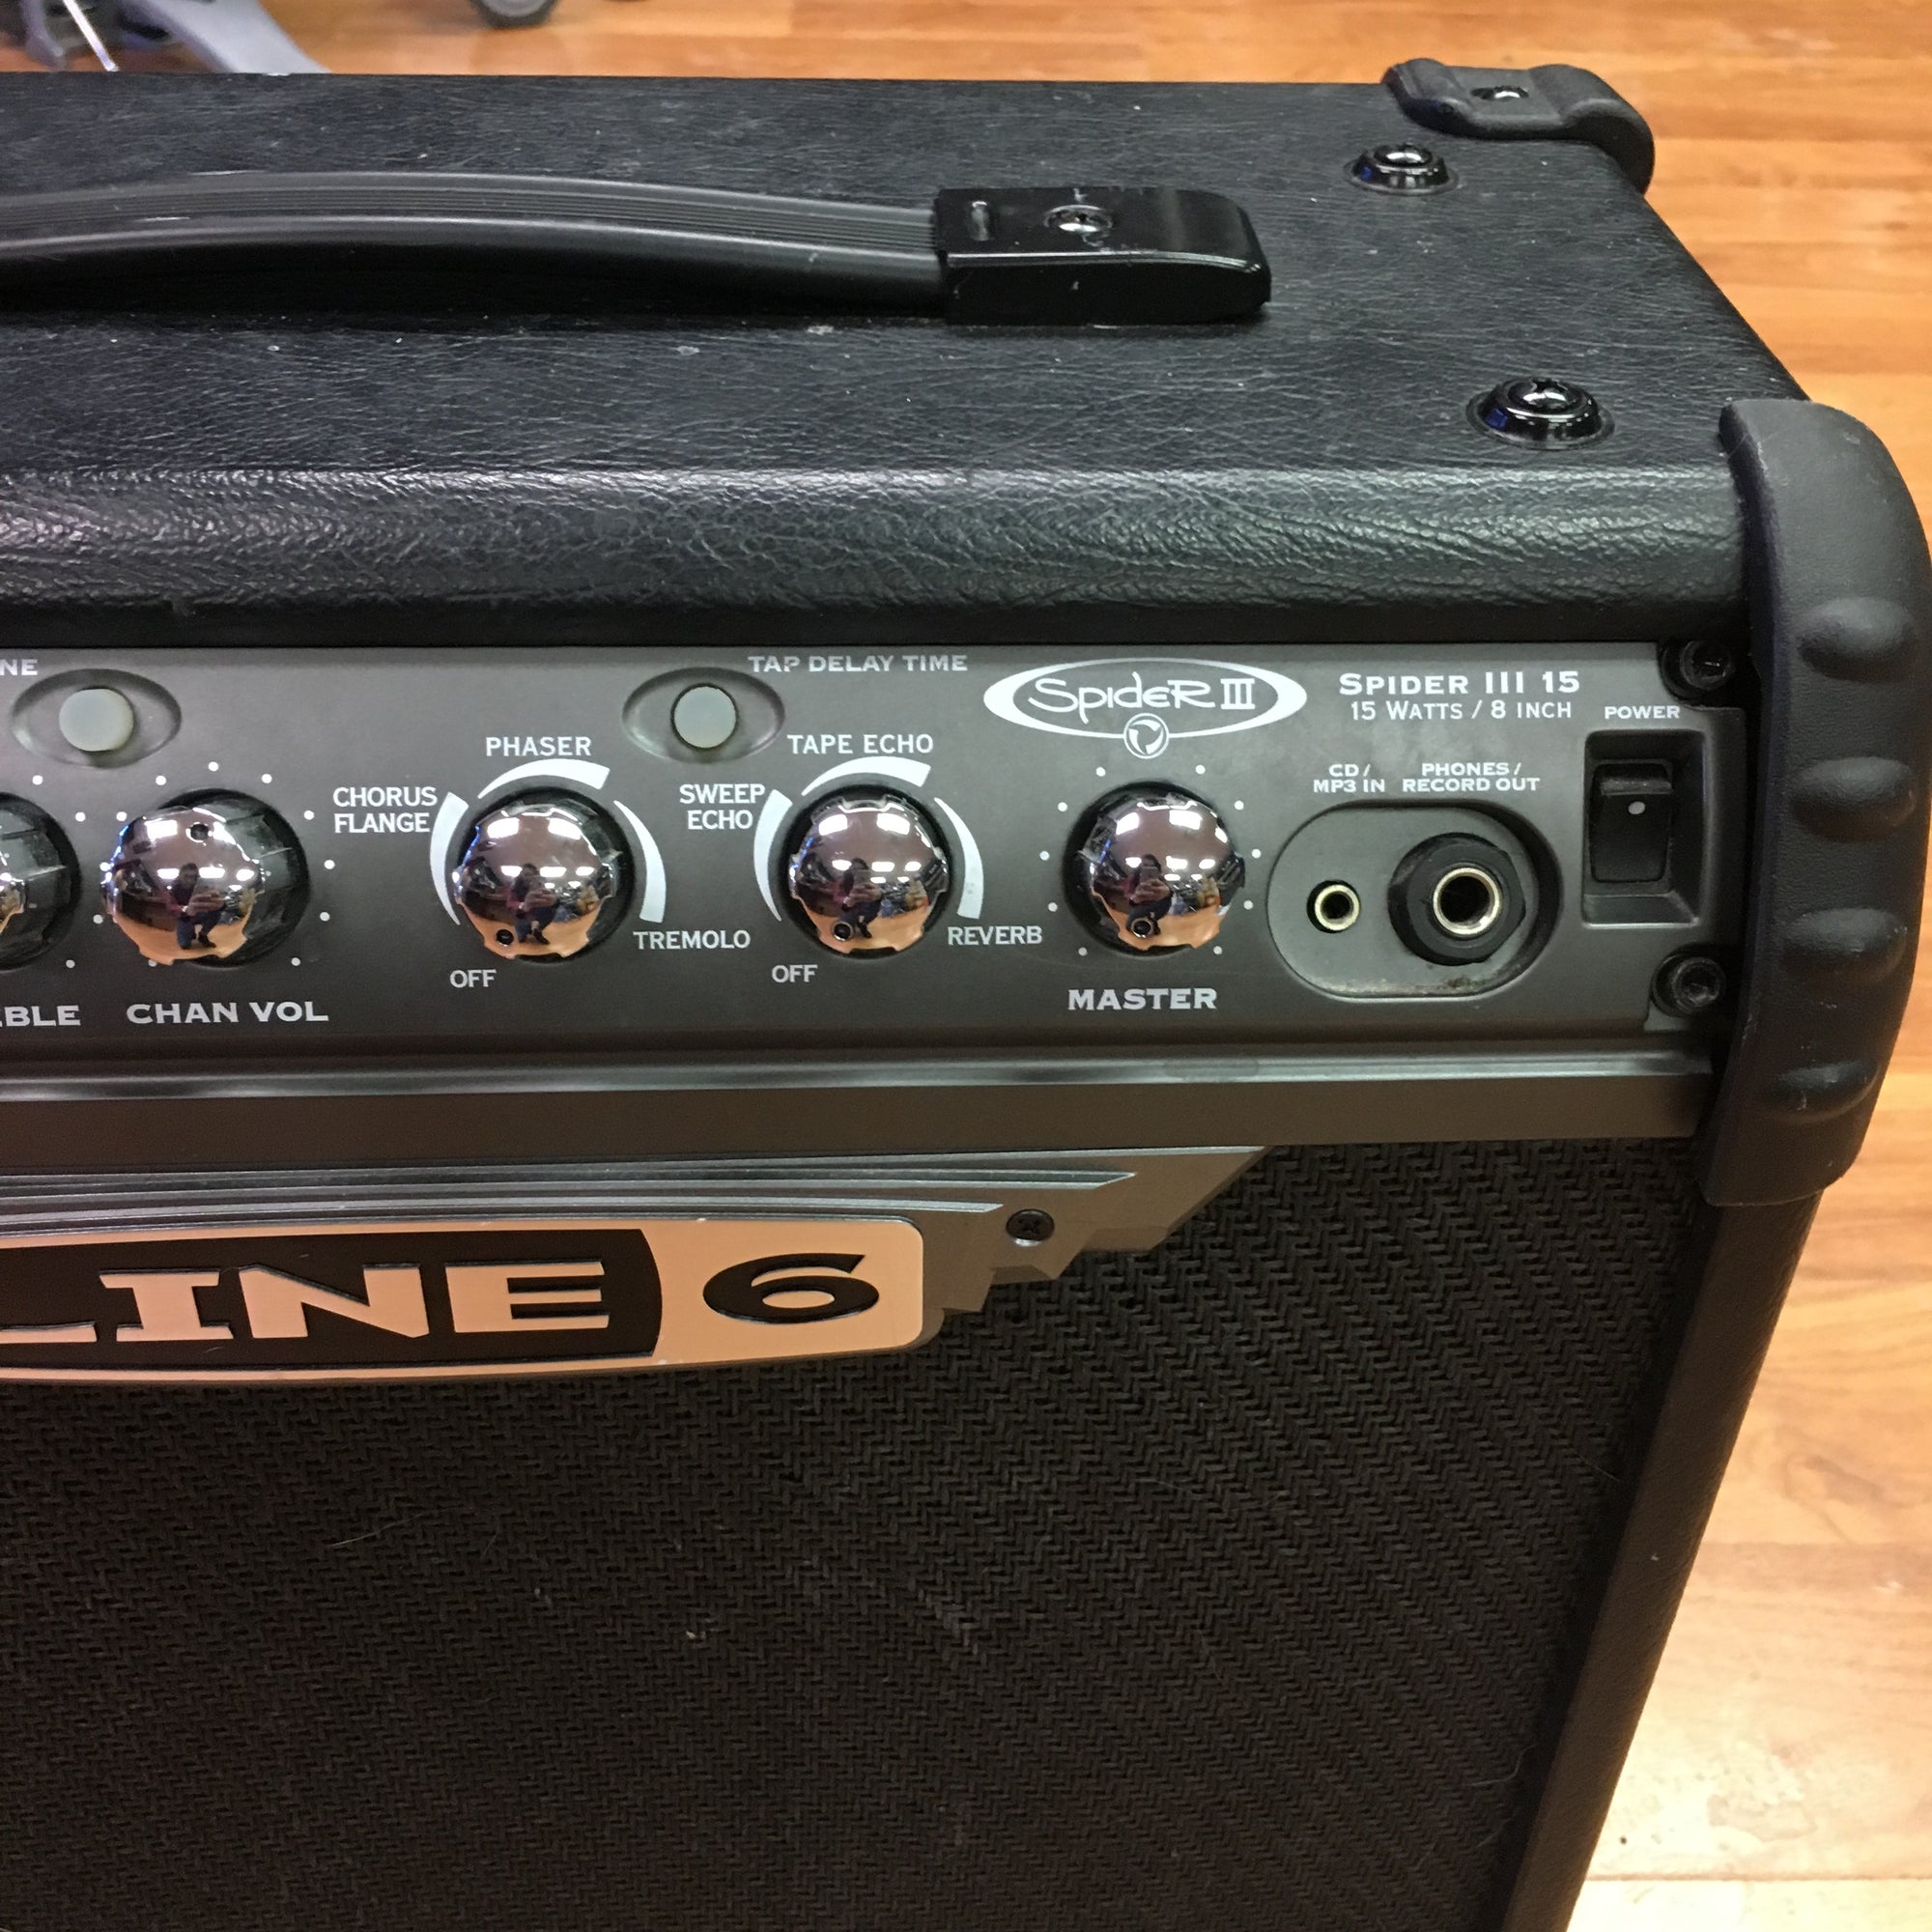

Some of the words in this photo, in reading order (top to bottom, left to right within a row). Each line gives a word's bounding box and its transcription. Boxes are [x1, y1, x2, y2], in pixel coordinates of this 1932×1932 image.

[748, 656, 799, 672] TAP
[809, 656, 895, 672] DELAY
[901, 655, 968, 671] TIME
[1485, 671, 1524, 694] III
[1542, 670, 1580, 694] 15
[1220, 678, 1256, 711] III
[1350, 702, 1377, 720] 15
[1491, 700, 1507, 718] 8
[1517, 700, 1573, 719] INCH
[1604, 705, 1681, 720] POWER
[485, 736, 592, 757] PHASER
[787, 734, 854, 754] TAPE
[863, 734, 934, 754] ECHO
[679, 783, 765, 805] SWEEP
[1313, 779, 1357, 794] MP3
[1362, 779, 1385, 792] IN
[1402, 778, 1492, 793] RECORD
[1496, 778, 1541, 792] OUT
[332, 786, 439, 808] CHORUS
[333, 812, 430, 834] FLANGE
[687, 810, 753, 830] ECHO
[633, 930, 752, 950] TREMOLO
[947, 925, 1042, 946] REVERB
[449, 969, 497, 989] OFF
[771, 964, 818, 983] OFF
[1067, 987, 1217, 1011] MASTER
[0, 1005, 81, 1027] BLE
[126, 1002, 239, 1024] CHAN
[248, 1001, 329, 1022] VOL
[702, 1252, 880, 1323] 6
